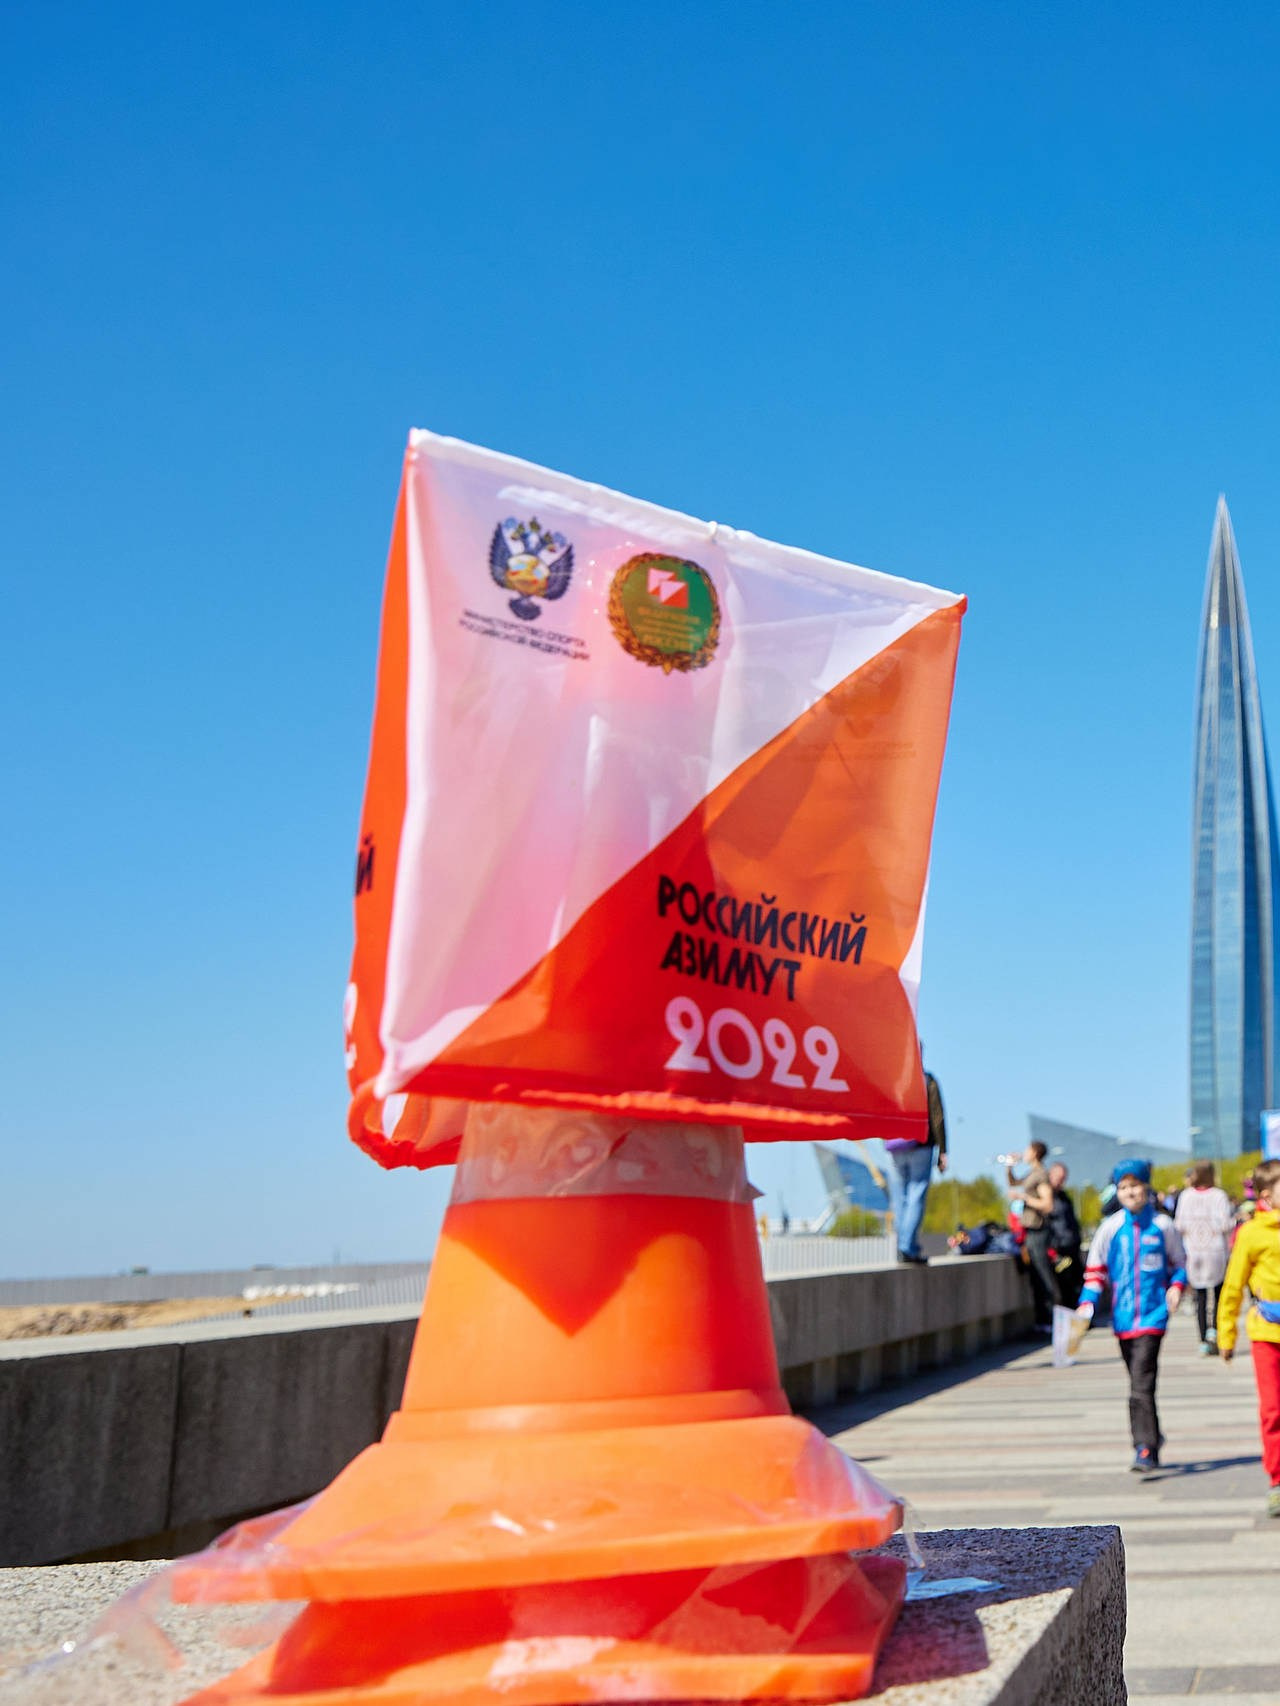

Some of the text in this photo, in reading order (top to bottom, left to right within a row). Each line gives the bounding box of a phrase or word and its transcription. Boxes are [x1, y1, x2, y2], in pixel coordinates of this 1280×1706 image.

[658, 874, 868, 965] РОССИЙСКИЙ
[660, 930, 802, 1001] АЗИМУТ
[664, 995, 850, 1092] 2022
